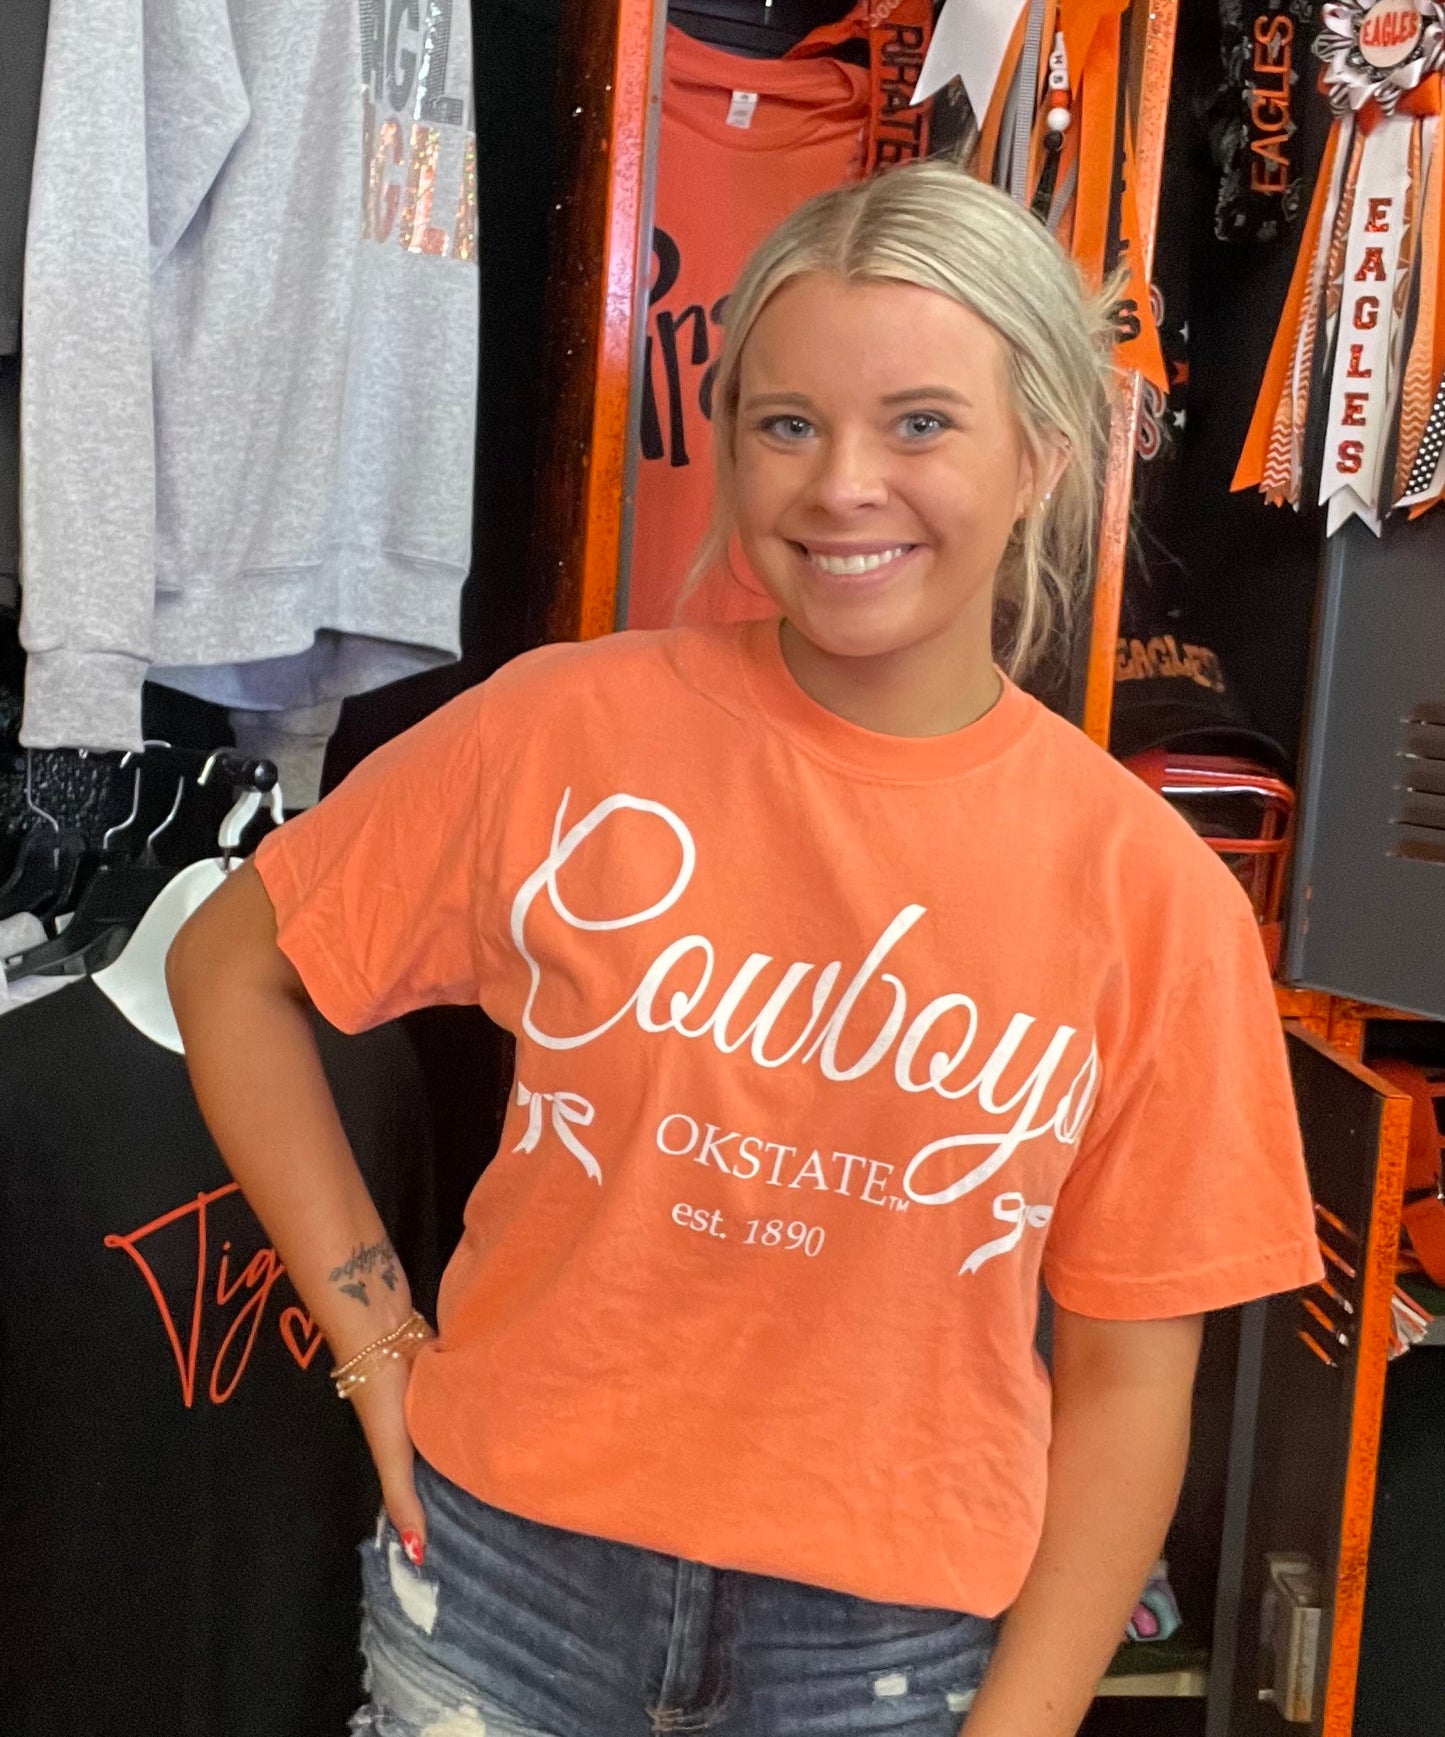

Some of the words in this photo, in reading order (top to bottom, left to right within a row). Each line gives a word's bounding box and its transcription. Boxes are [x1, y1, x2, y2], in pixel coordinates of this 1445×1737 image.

[1361, 10, 1419, 47] EAGLES
[1251, 14, 1294, 193] EAGLES
[1336, 197, 1392, 475] EAGLES
[511, 786, 1098, 1204] Cowboys
[655, 1113, 894, 1206] OKSTATE
[672, 1202, 727, 1240] est.
[743, 1217, 826, 1257] 1890
